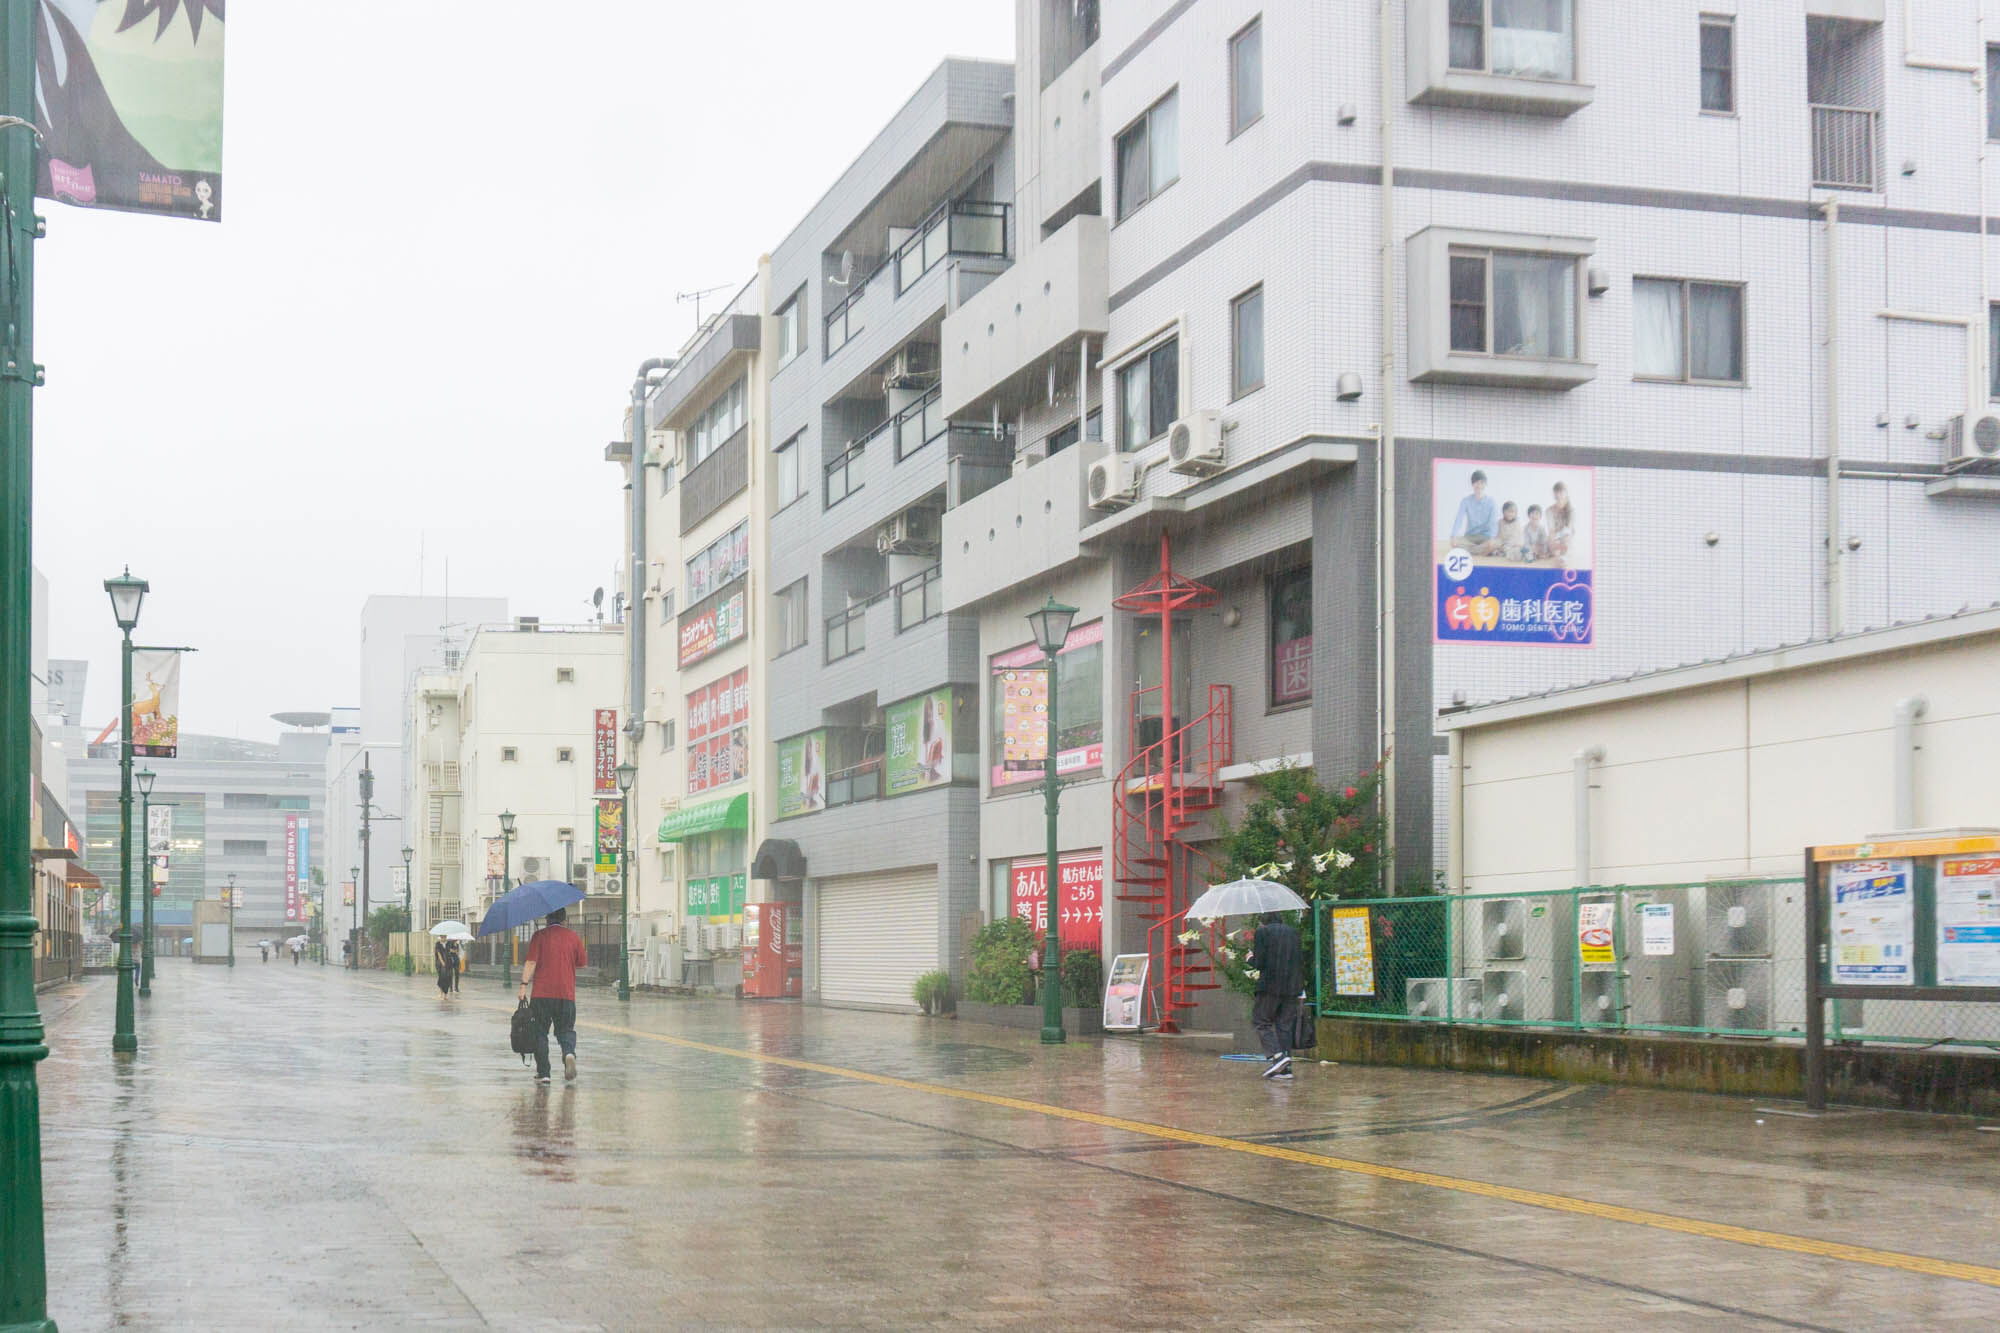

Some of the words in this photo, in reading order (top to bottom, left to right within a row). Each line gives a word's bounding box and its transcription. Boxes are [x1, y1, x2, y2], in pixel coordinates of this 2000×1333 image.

[139, 171, 183, 185] YAMATO
[1449, 556, 1469, 572] 2F
[1503, 624, 1525, 632] TOMO
[1528, 624, 1555, 633] DENTA
[1281, 643, 1312, 696] 歯
[1062, 865, 1103, 885] 処方せんは
[1071, 884, 1095, 901] こちら
